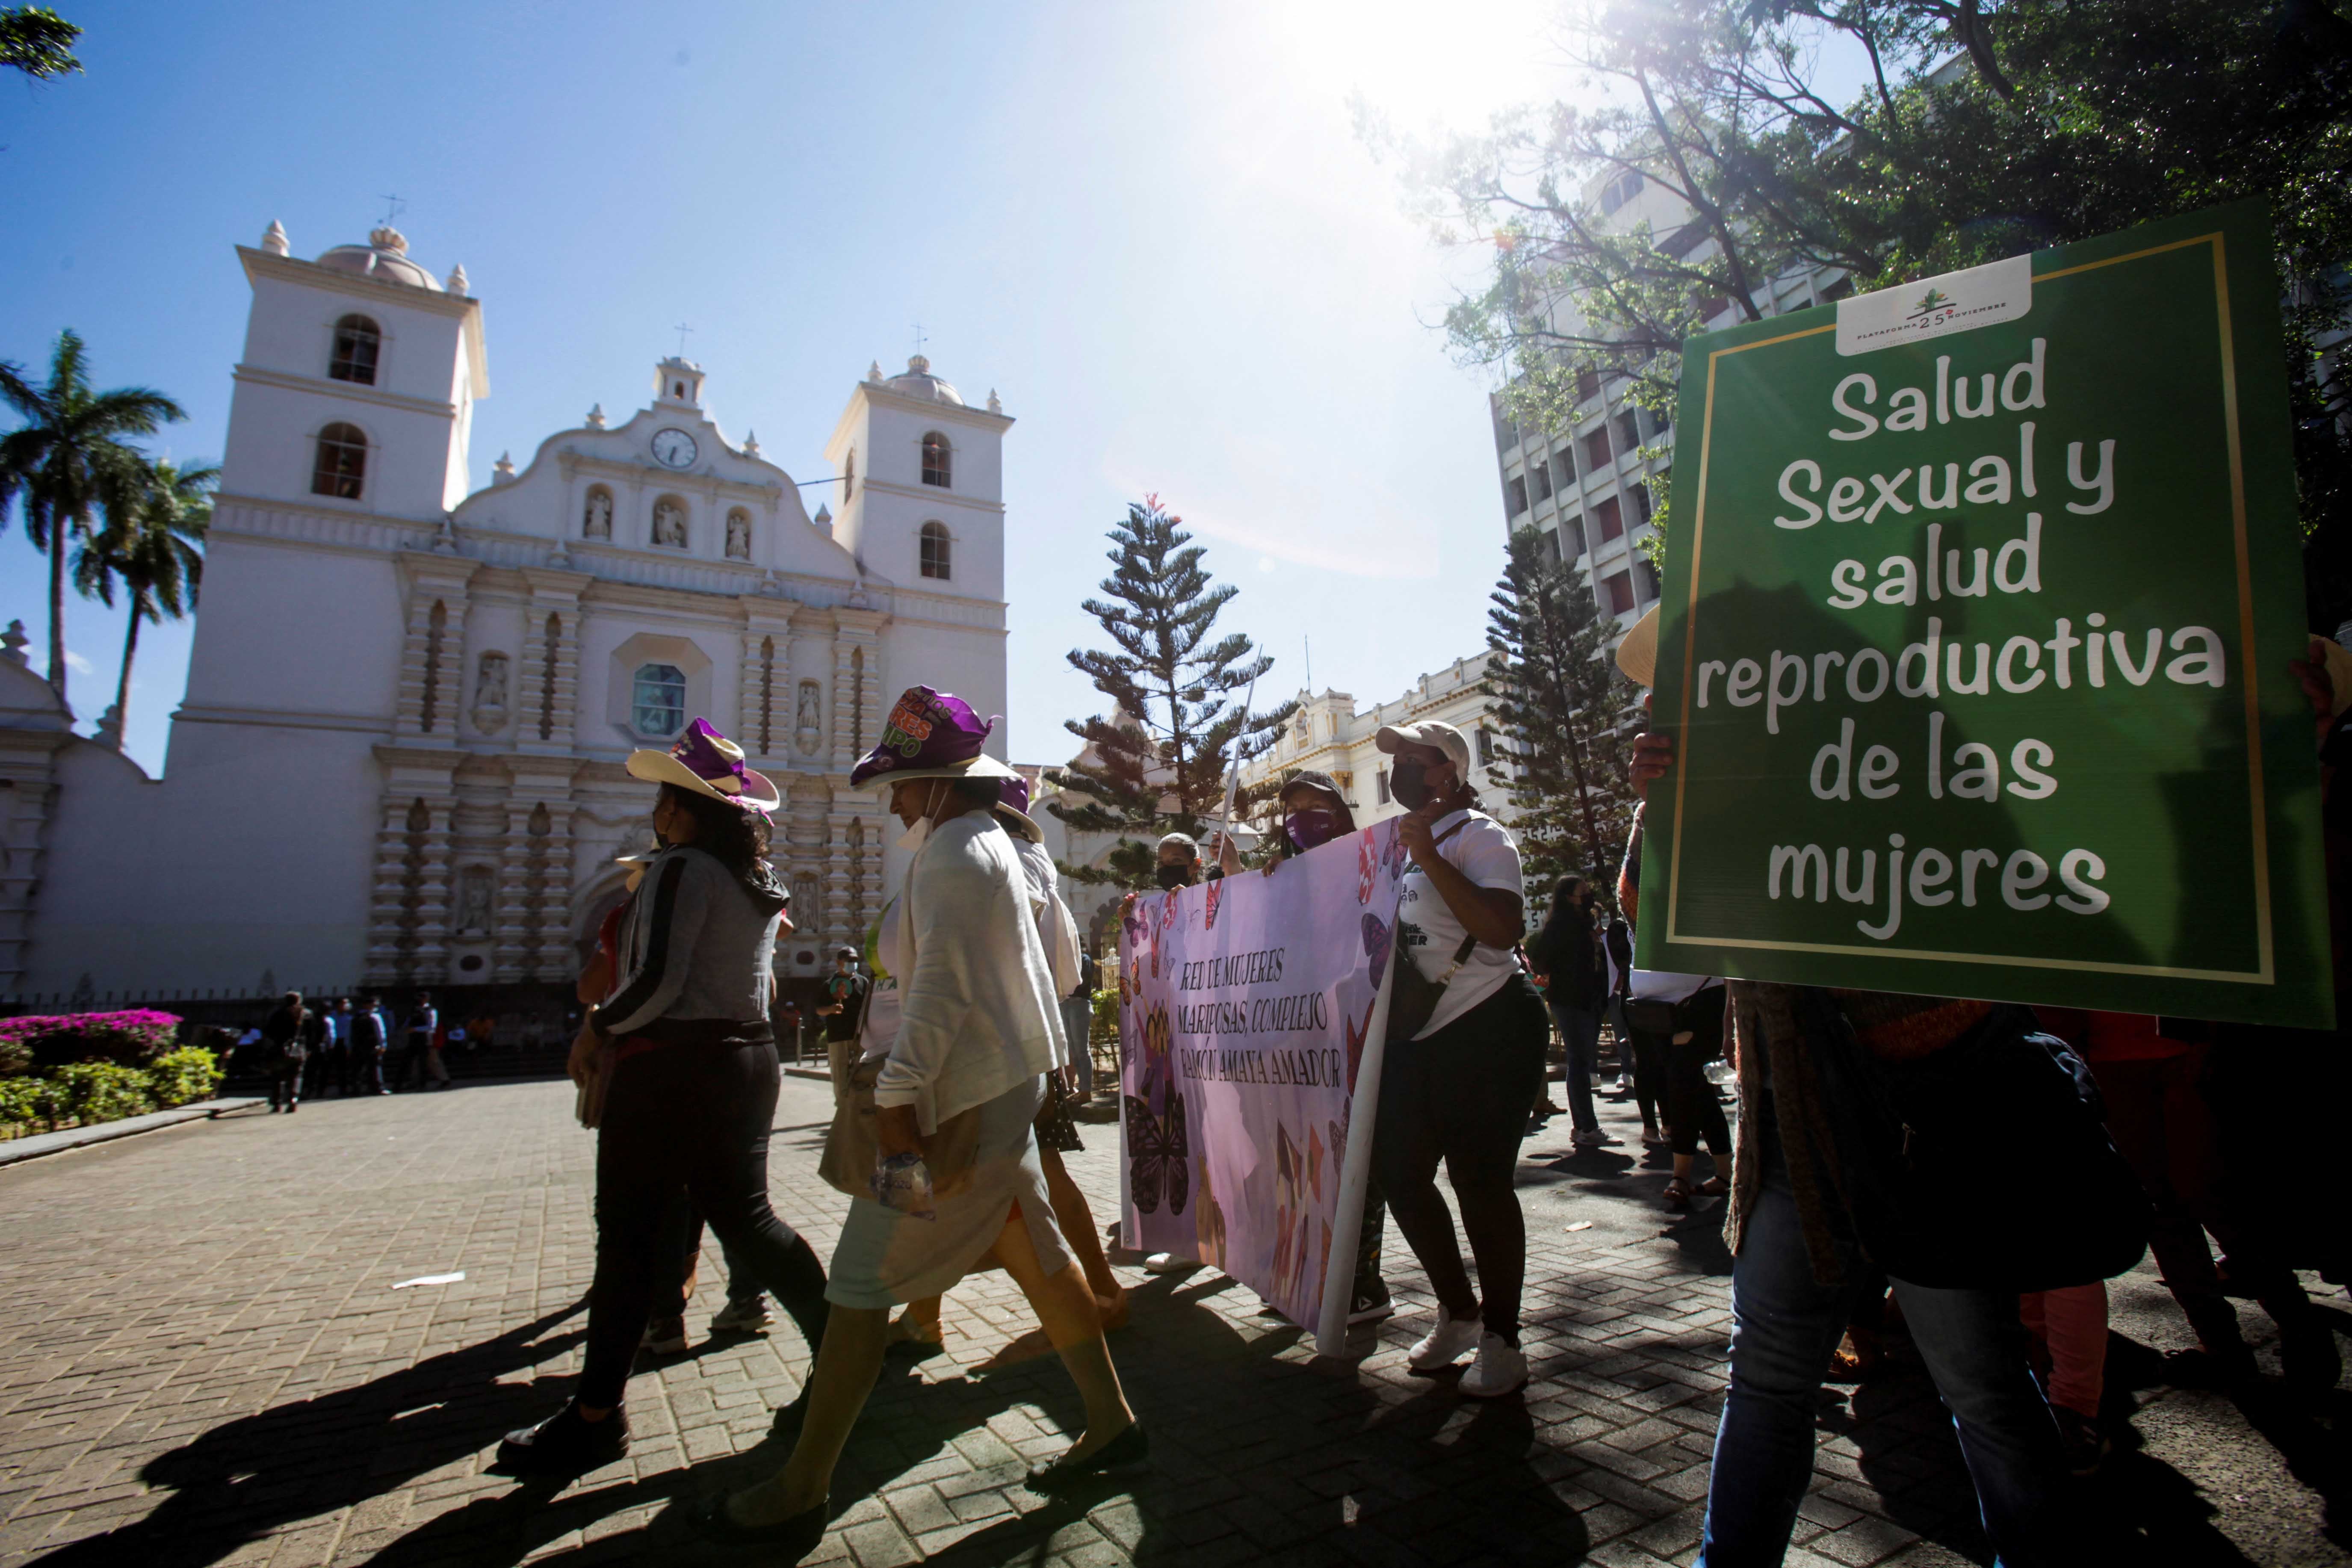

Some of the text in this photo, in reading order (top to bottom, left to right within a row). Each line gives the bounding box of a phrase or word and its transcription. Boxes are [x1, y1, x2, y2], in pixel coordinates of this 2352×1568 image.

[1857, 323, 1918, 340] PLATAFORMA
[1920, 313, 1944, 329] 25
[1948, 302, 2007, 320] NOVIEMBRE
[1828, 337, 2046, 441] Salud
[1773, 422, 2115, 530] Sexual y
[1827, 512, 2042, 609] salud
[1697, 613, 2224, 734] reproductiva
[1810, 712, 2057, 802] de las
[1769, 834, 2110, 939] mujeres
[1178, 992, 1327, 1037] MARIPOSAS, COMPLEJO
[1180, 947, 1285, 990] RED DE MUJERES
[1181, 1036, 1341, 1088] RAMÓN AMAYA AMADOR
